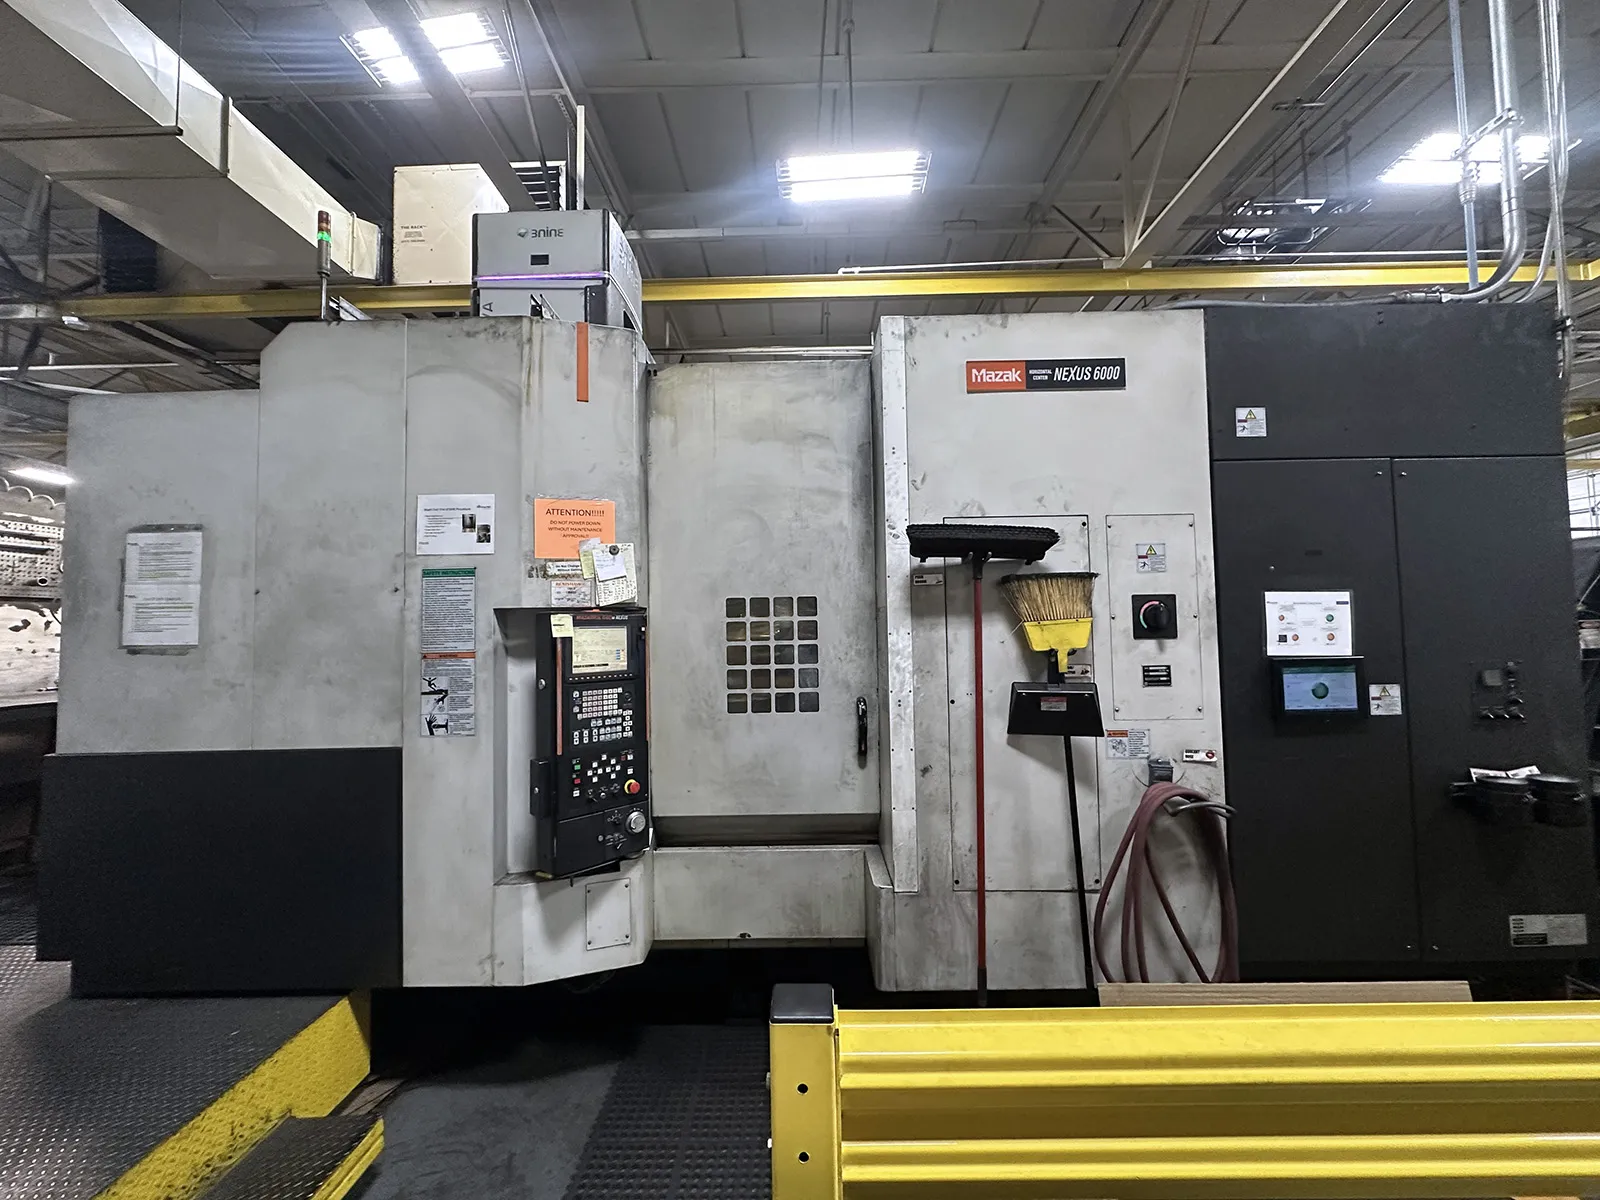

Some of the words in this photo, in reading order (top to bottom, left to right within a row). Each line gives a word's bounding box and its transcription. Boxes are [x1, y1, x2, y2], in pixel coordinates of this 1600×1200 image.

[971, 367, 1022, 383] Mazak
[1053, 366, 1092, 382] NEXUS
[1093, 365, 1121, 381] 6000
